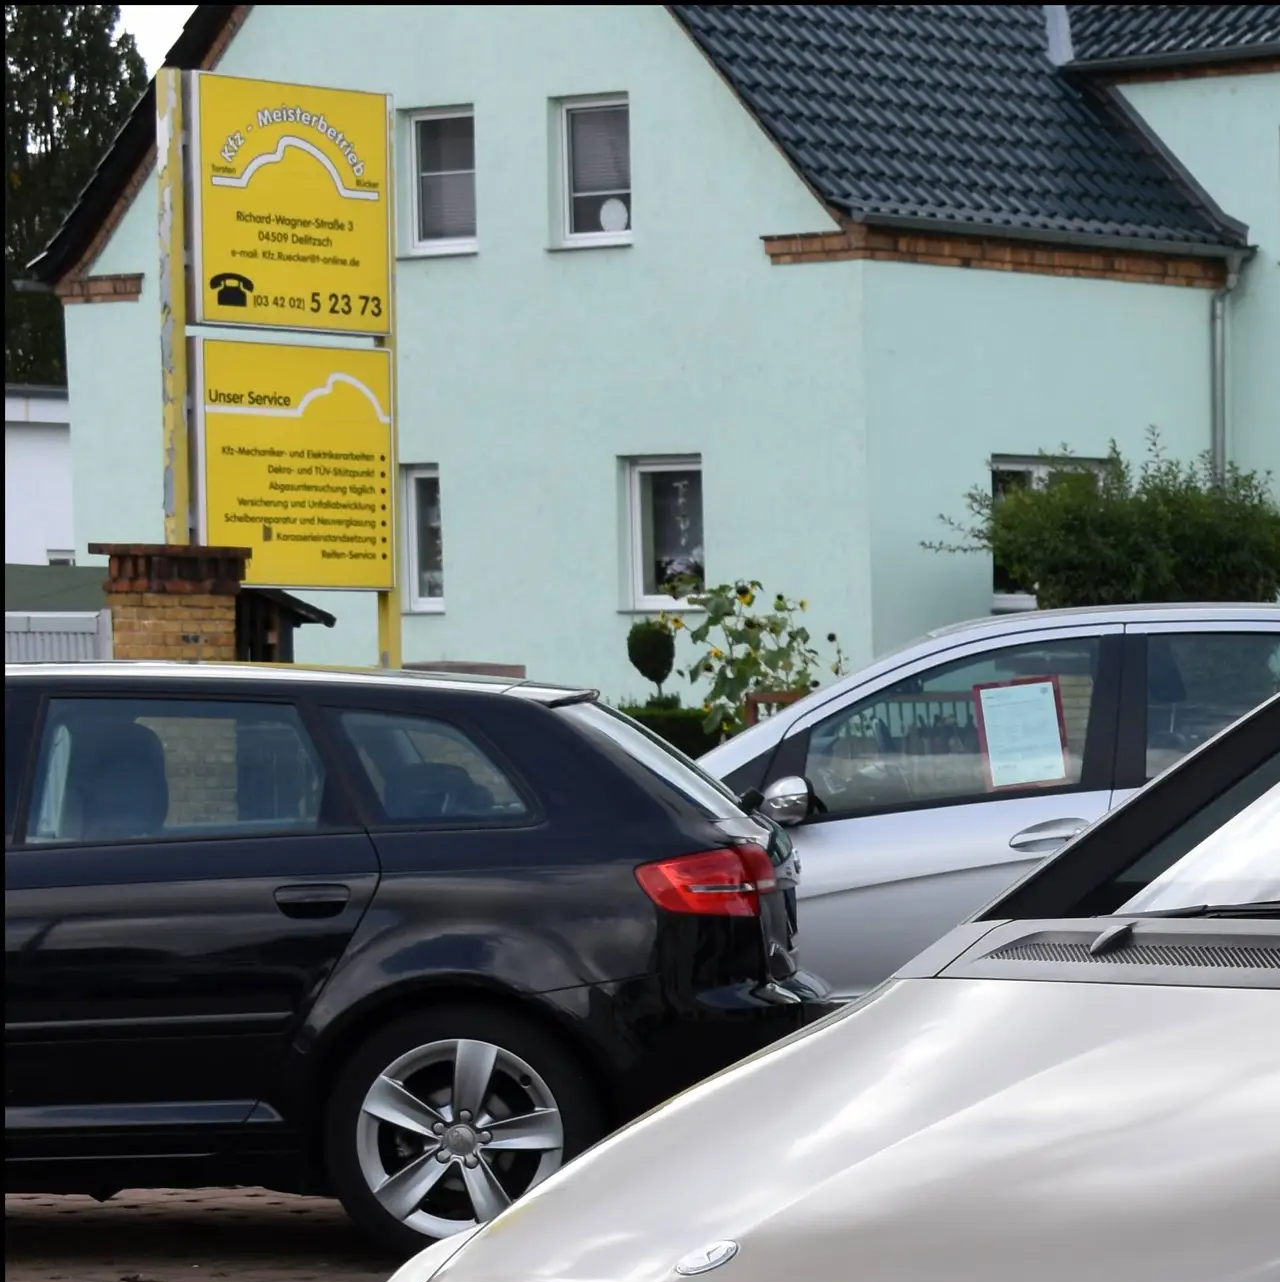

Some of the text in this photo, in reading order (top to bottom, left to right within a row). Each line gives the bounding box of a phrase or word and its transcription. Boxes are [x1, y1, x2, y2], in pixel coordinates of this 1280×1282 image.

[220, 131, 245, 162] Kfz
[257, 103, 365, 176] Meisterbetrieb
[236, 211, 354, 232] Richard-Wagner-Straße 3
[258, 231, 333, 247] 04509 Delitzsch
[273, 296, 286, 309] 42
[310, 292, 321, 313] 5
[328, 293, 352, 315] 23
[358, 295, 382, 317] 73
[208, 389, 291, 407] Unser Service
[289, 448, 305, 459] und
[297, 465, 312, 476] und
[269, 482, 375, 497] Abgasuntersuchung täglich
[237, 497, 375, 513] Versicherung und Unfallabwicklung
[224, 513, 297, 526] Scheibenreparatur
[300, 515, 315, 526] und
